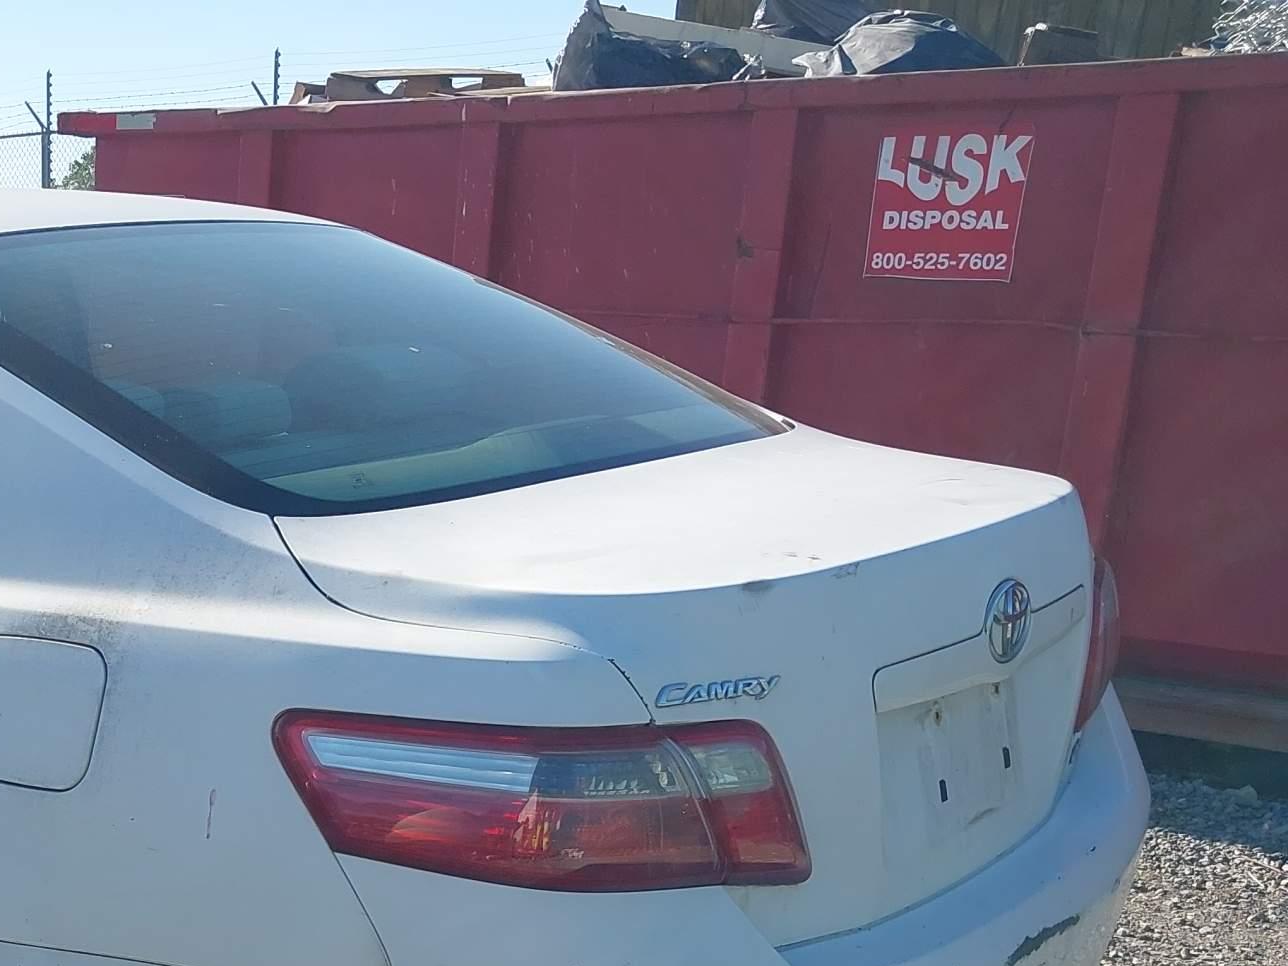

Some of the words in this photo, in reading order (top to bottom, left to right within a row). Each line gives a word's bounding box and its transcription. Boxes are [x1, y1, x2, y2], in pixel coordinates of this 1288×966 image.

[877, 133, 1033, 206] LUSK
[882, 210, 1009, 230] DISPOSAL
[871, 252, 1008, 270] 800-525-7602
[655, 674, 781, 708] CAMRY
